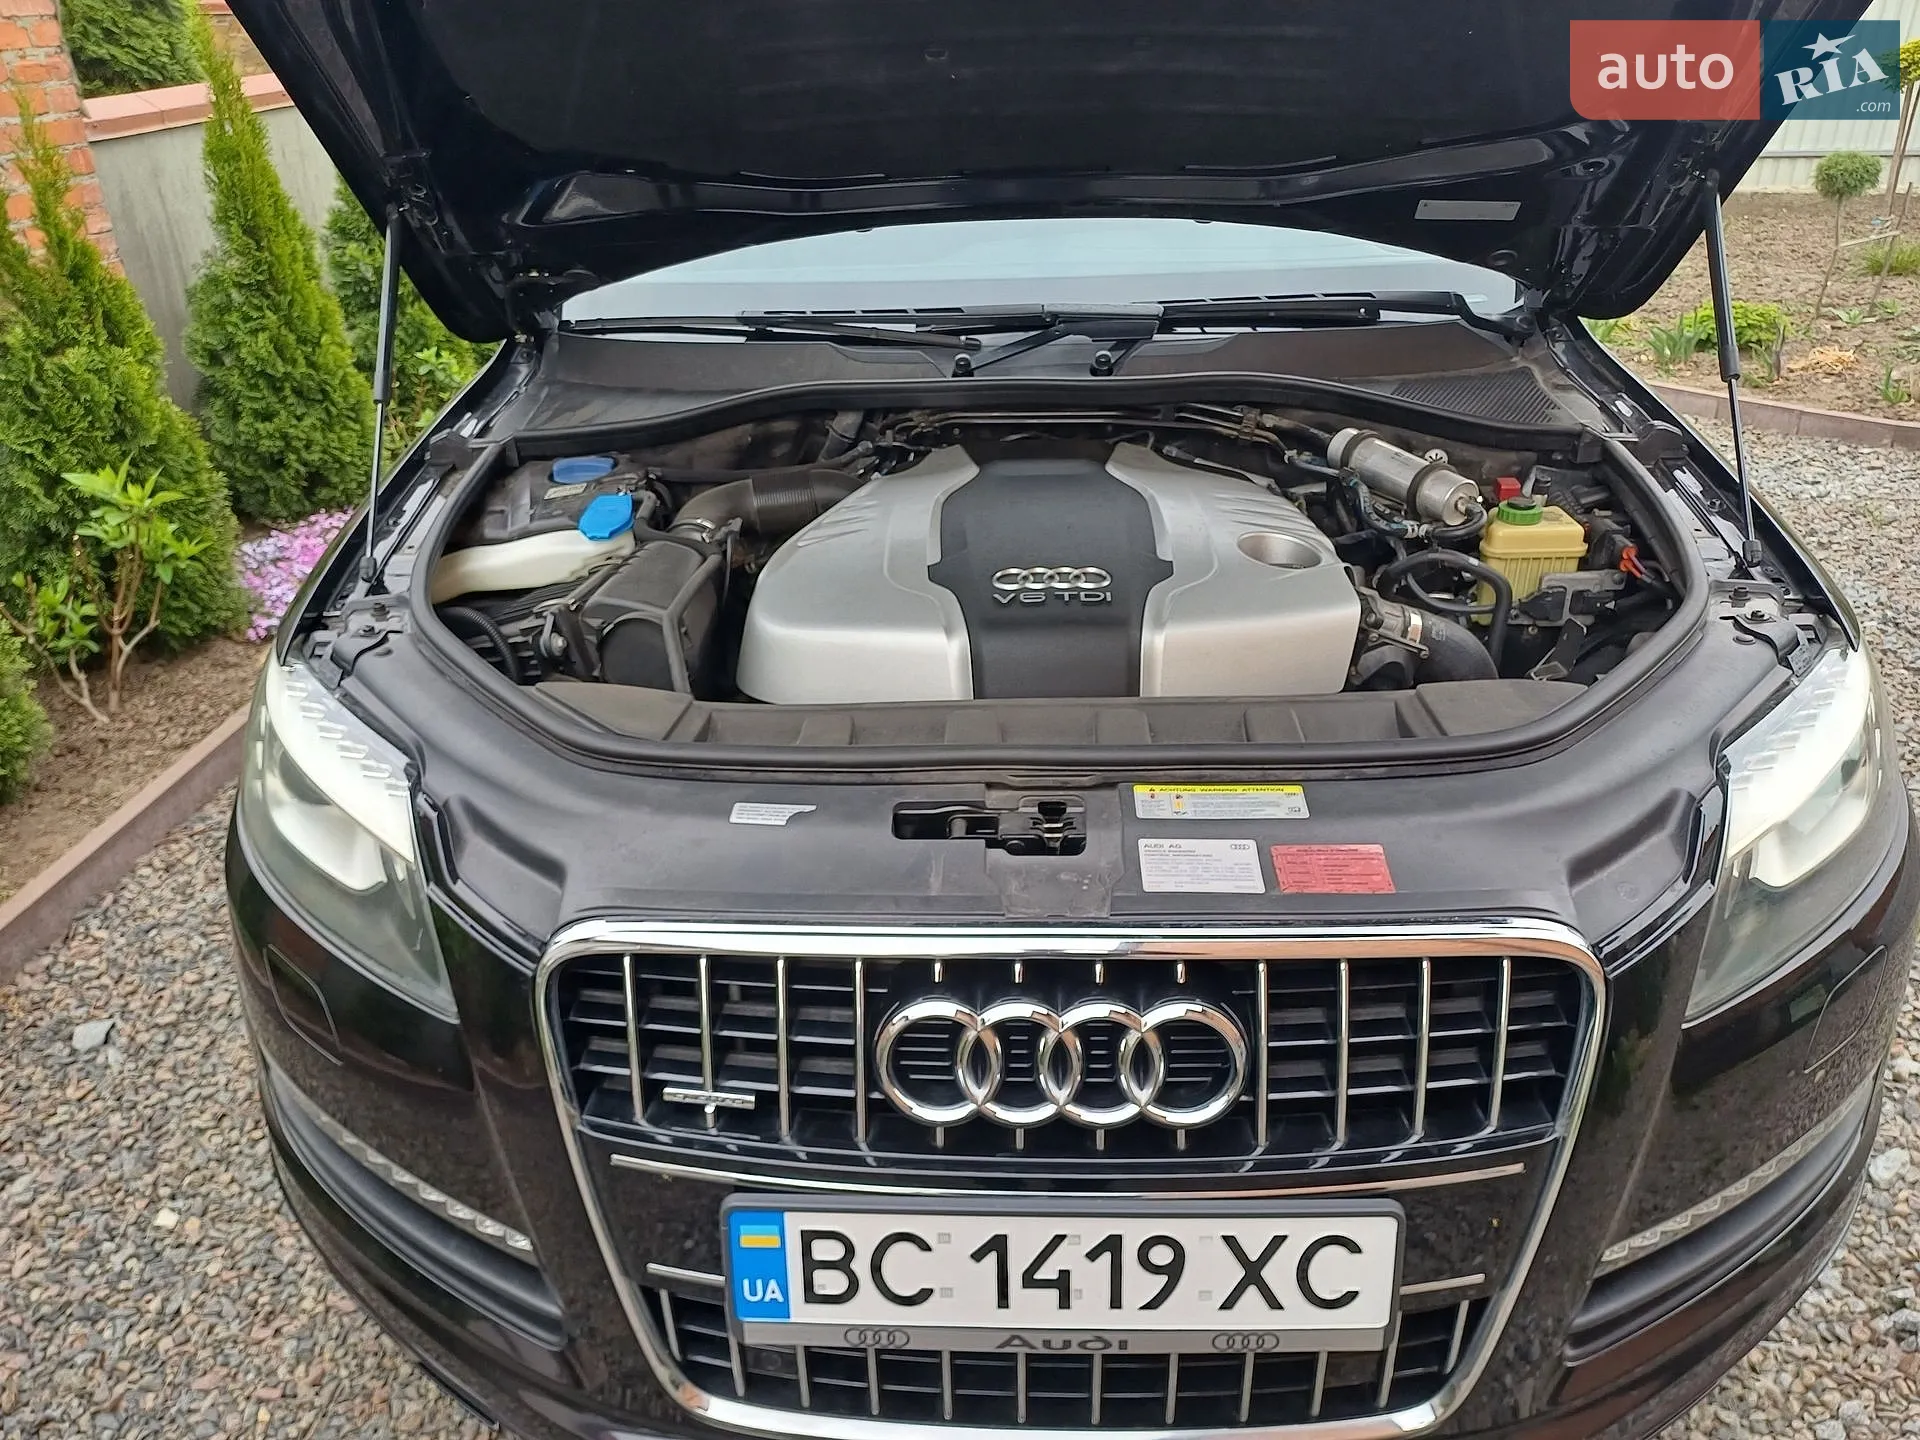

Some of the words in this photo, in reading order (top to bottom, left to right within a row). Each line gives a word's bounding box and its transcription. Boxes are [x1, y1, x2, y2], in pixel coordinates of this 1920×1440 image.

[992, 591, 1046, 604] V6
[1054, 591, 1112, 602] TDI
[800, 1229, 934, 1307] BC
[969, 1233, 1186, 1310] 1419
[1217, 1234, 1364, 1310] XC
[742, 1278, 785, 1303] UA
[995, 1334, 1128, 1351] Audi
